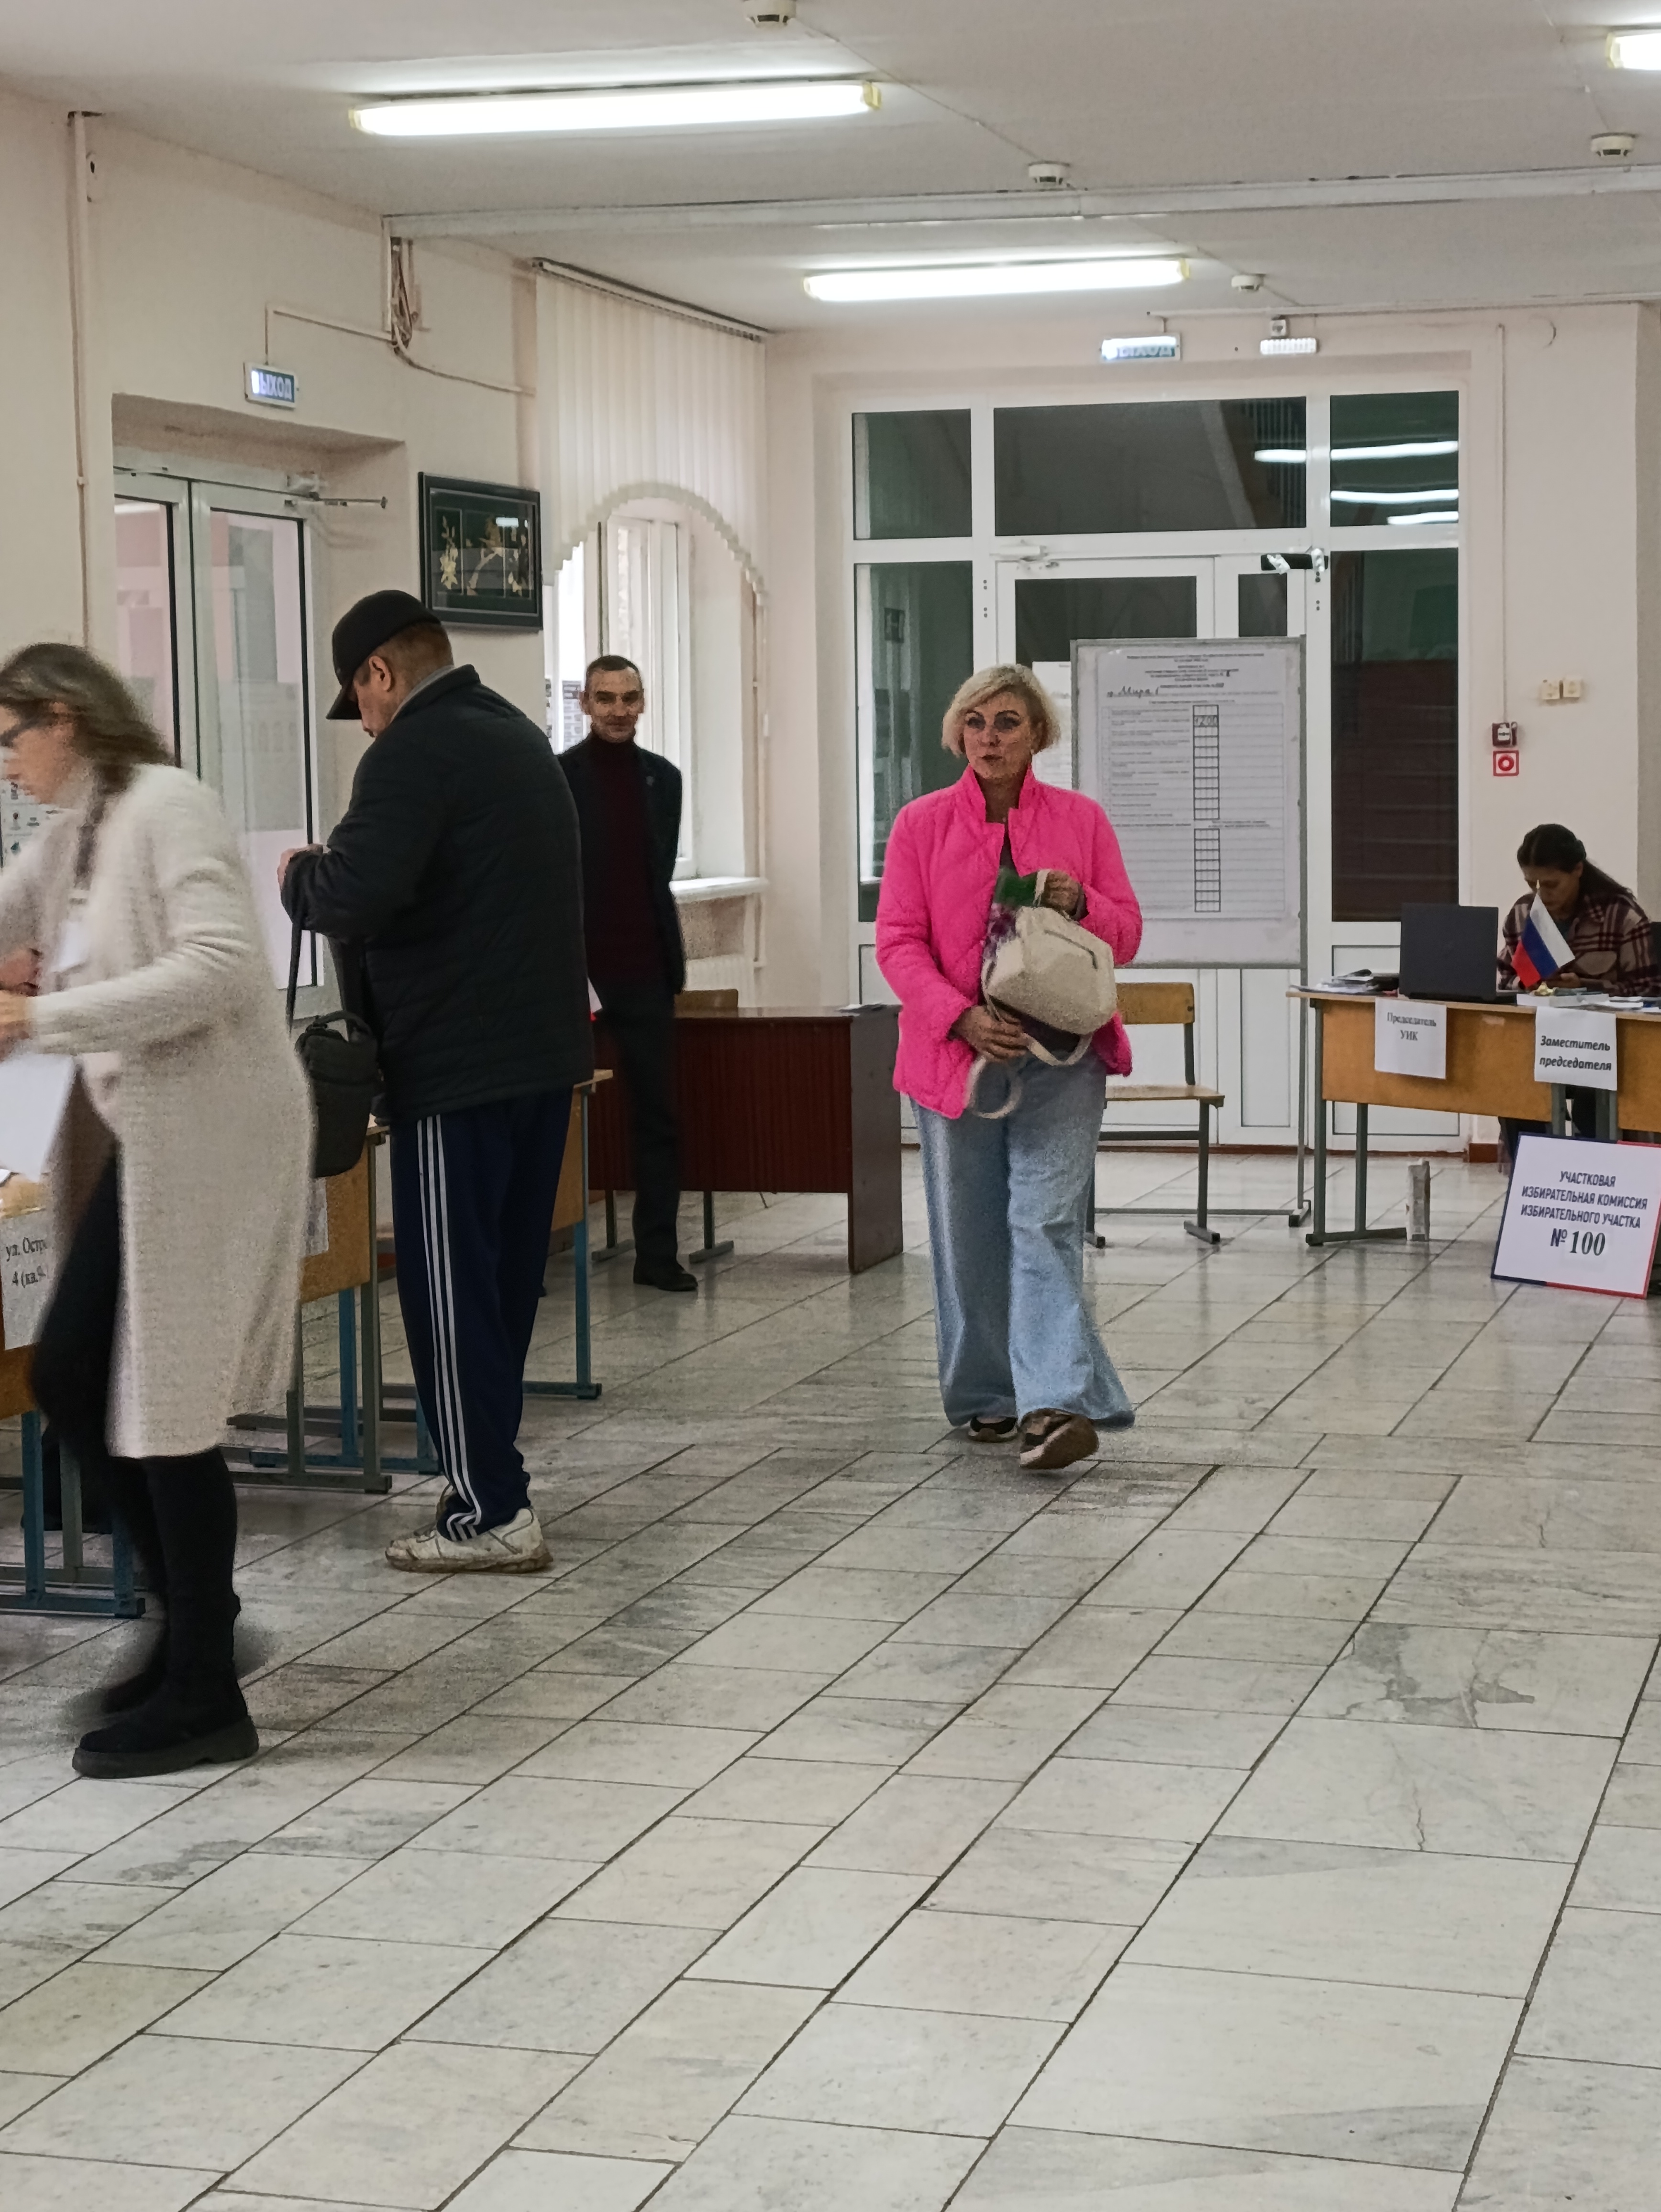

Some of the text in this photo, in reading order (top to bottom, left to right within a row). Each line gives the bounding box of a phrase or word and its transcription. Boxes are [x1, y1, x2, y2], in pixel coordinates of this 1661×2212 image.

[1102, 339, 1172, 357] ЫХОД
[251, 370, 292, 400] ЫХОД
[1387, 1012, 1437, 1027] Председатель
[1400, 1029, 1418, 1041] УИК
[1540, 1035, 1611, 1051] Заместитель
[1539, 1056, 1612, 1071] председателя
[1559, 1171, 1616, 1187] УЧАСТКОВАЯ
[1521, 1186, 1648, 1210] ИЗБИРАТЕЛЬНАЯ КОМИССИЯ
[1520, 1204, 1641, 1228] ИЗБИРАТЕЛЬНОГО УЧАСТКА
[1550, 1228, 1606, 1256] № 100
